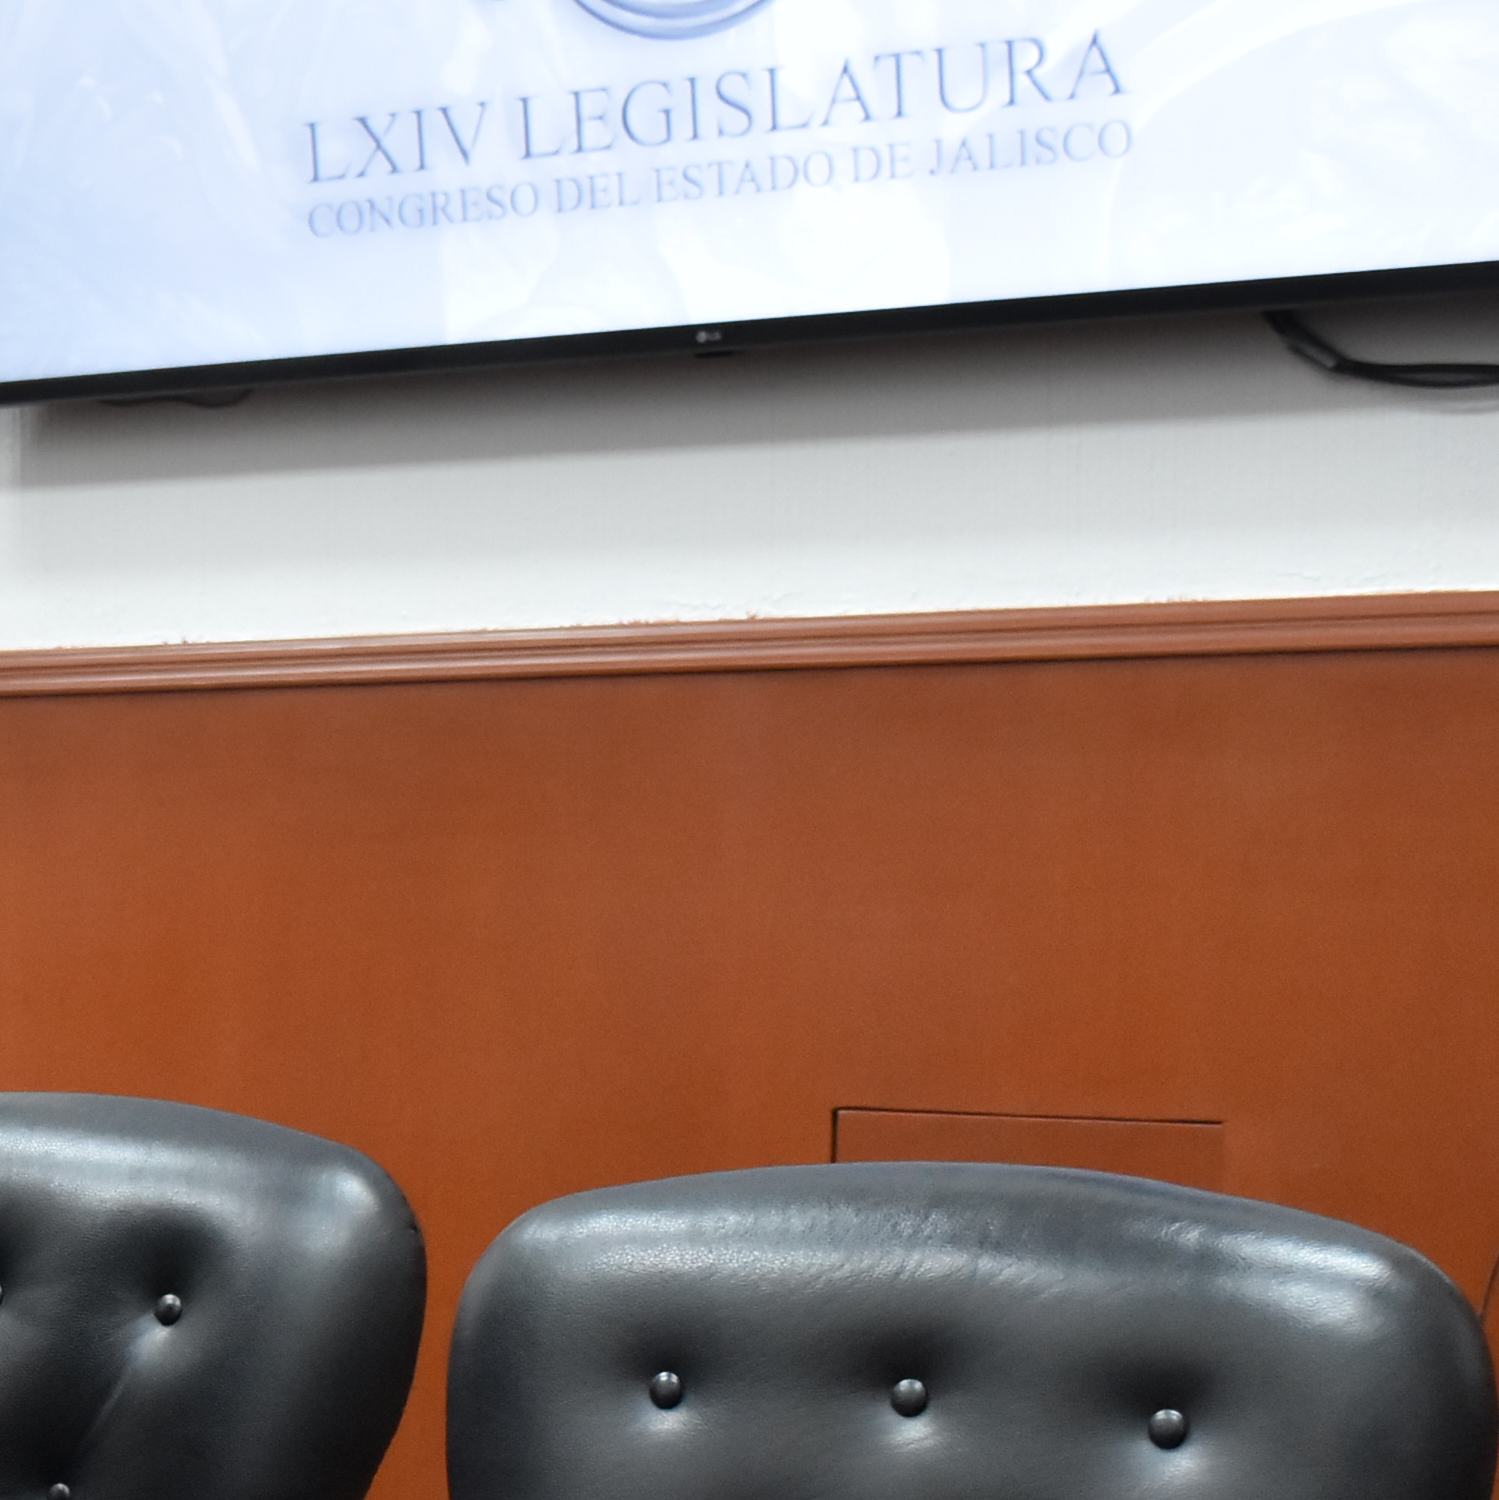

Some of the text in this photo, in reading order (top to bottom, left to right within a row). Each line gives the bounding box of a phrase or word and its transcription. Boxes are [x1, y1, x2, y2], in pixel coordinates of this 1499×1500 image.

[304, 27, 1132, 184] LXIV LEGISLATURA
[307, 118, 1132, 238] CONGRESO DEL ESTADO DE JALISCO
